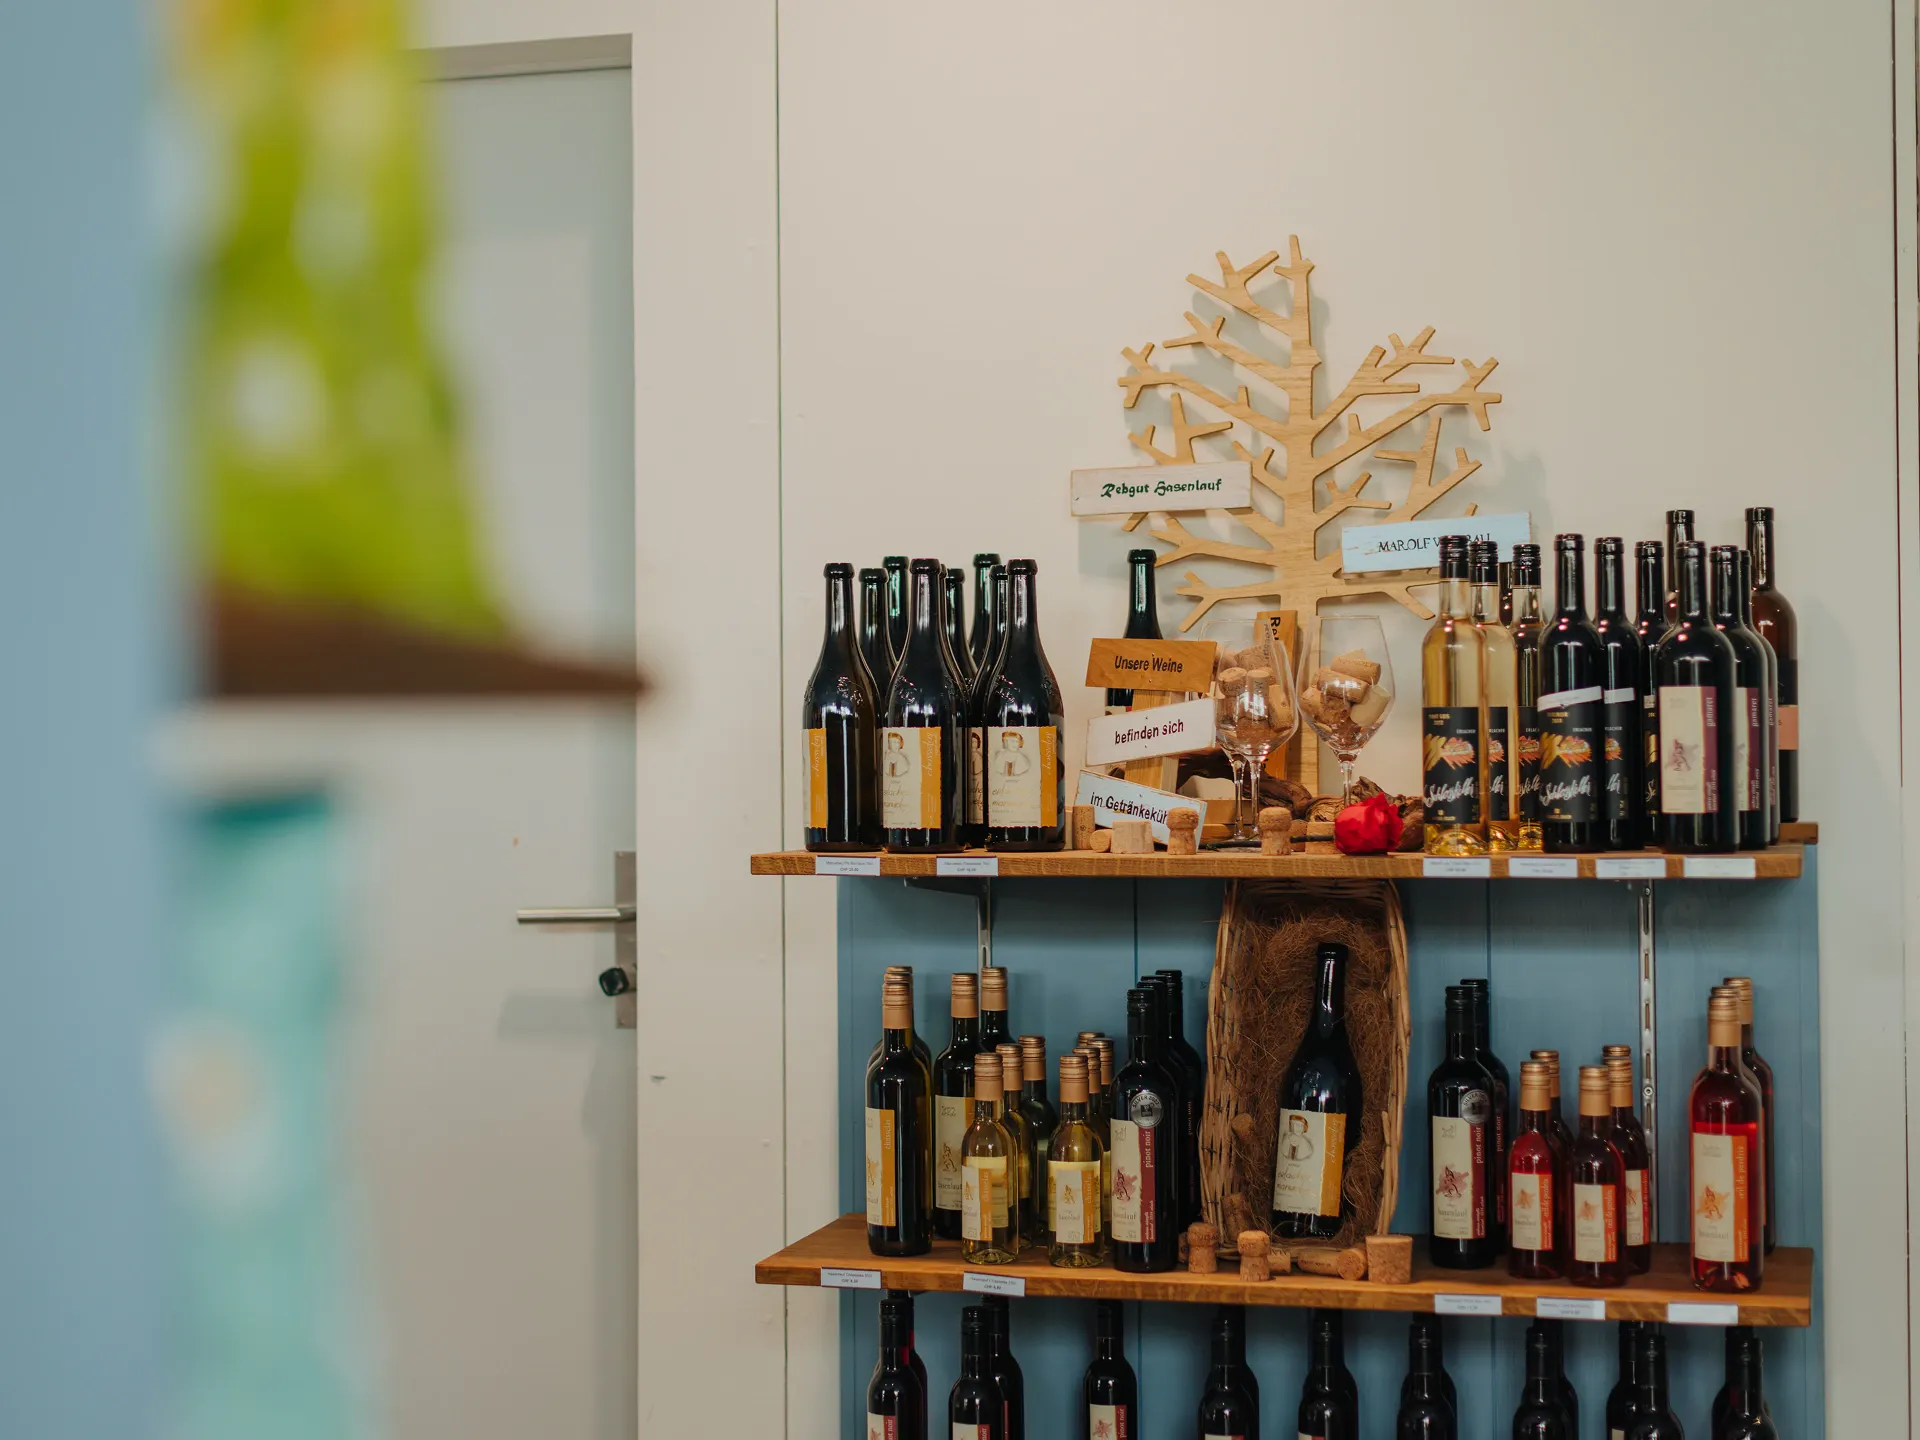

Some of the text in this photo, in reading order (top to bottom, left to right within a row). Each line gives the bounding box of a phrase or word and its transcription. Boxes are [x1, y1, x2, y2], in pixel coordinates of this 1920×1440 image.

[1101, 478, 1222, 498] Rebgut Hasenlauf
[1379, 537, 1431, 552] MAROLF
[1114, 655, 1183, 672] Unsere Weine
[1706, 697, 1716, 727] gamaret
[1752, 698, 1760, 727] gamaret
[1115, 718, 1184, 745] befinden sich
[1090, 792, 1168, 825] im Getränkeküh
[1143, 1131, 1154, 1168] pinot noir
[1474, 1127, 1484, 1164] pinot noir
[1117, 1408, 1127, 1438] pinot noir
